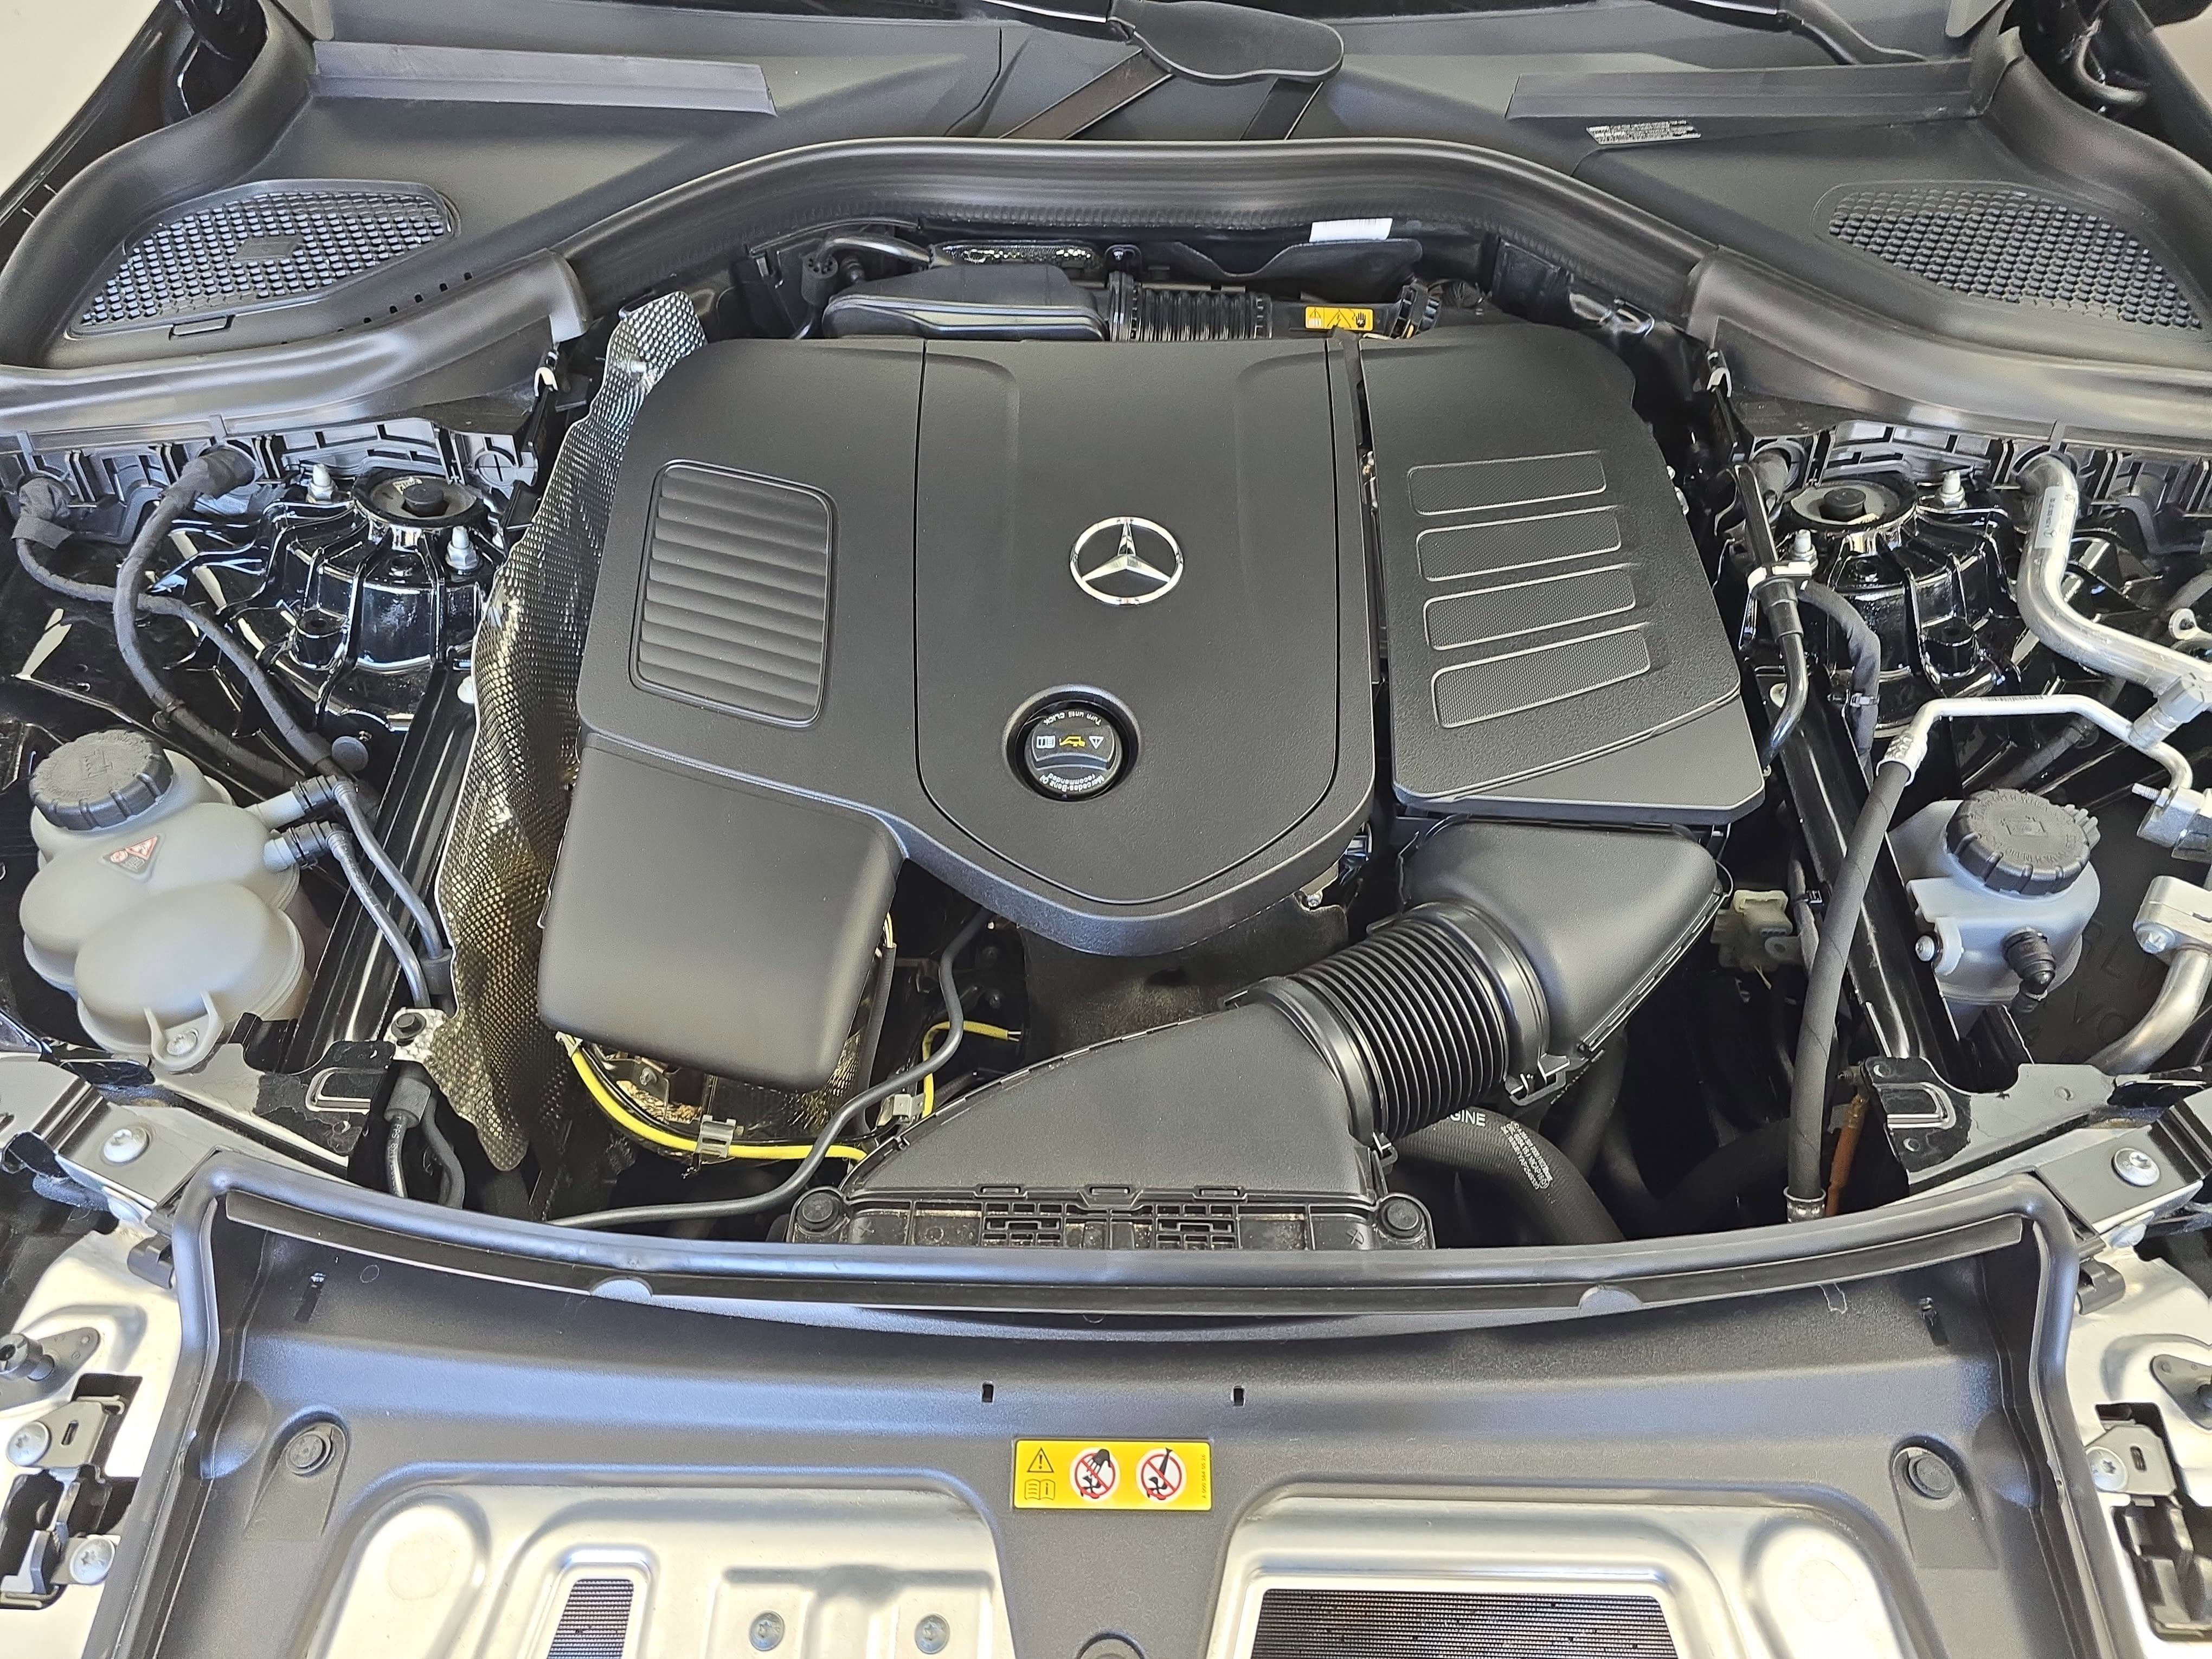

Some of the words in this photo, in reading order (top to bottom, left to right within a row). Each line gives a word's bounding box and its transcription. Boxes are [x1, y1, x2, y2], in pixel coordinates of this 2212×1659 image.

[1043, 712, 1065, 725] CLICK
[1086, 713, 1102, 726] Turn
[1048, 773, 1096, 785] recommended
[1049, 775, 1105, 792] Mercedes-Benz
[1446, 1109, 1486, 1127] GINE
